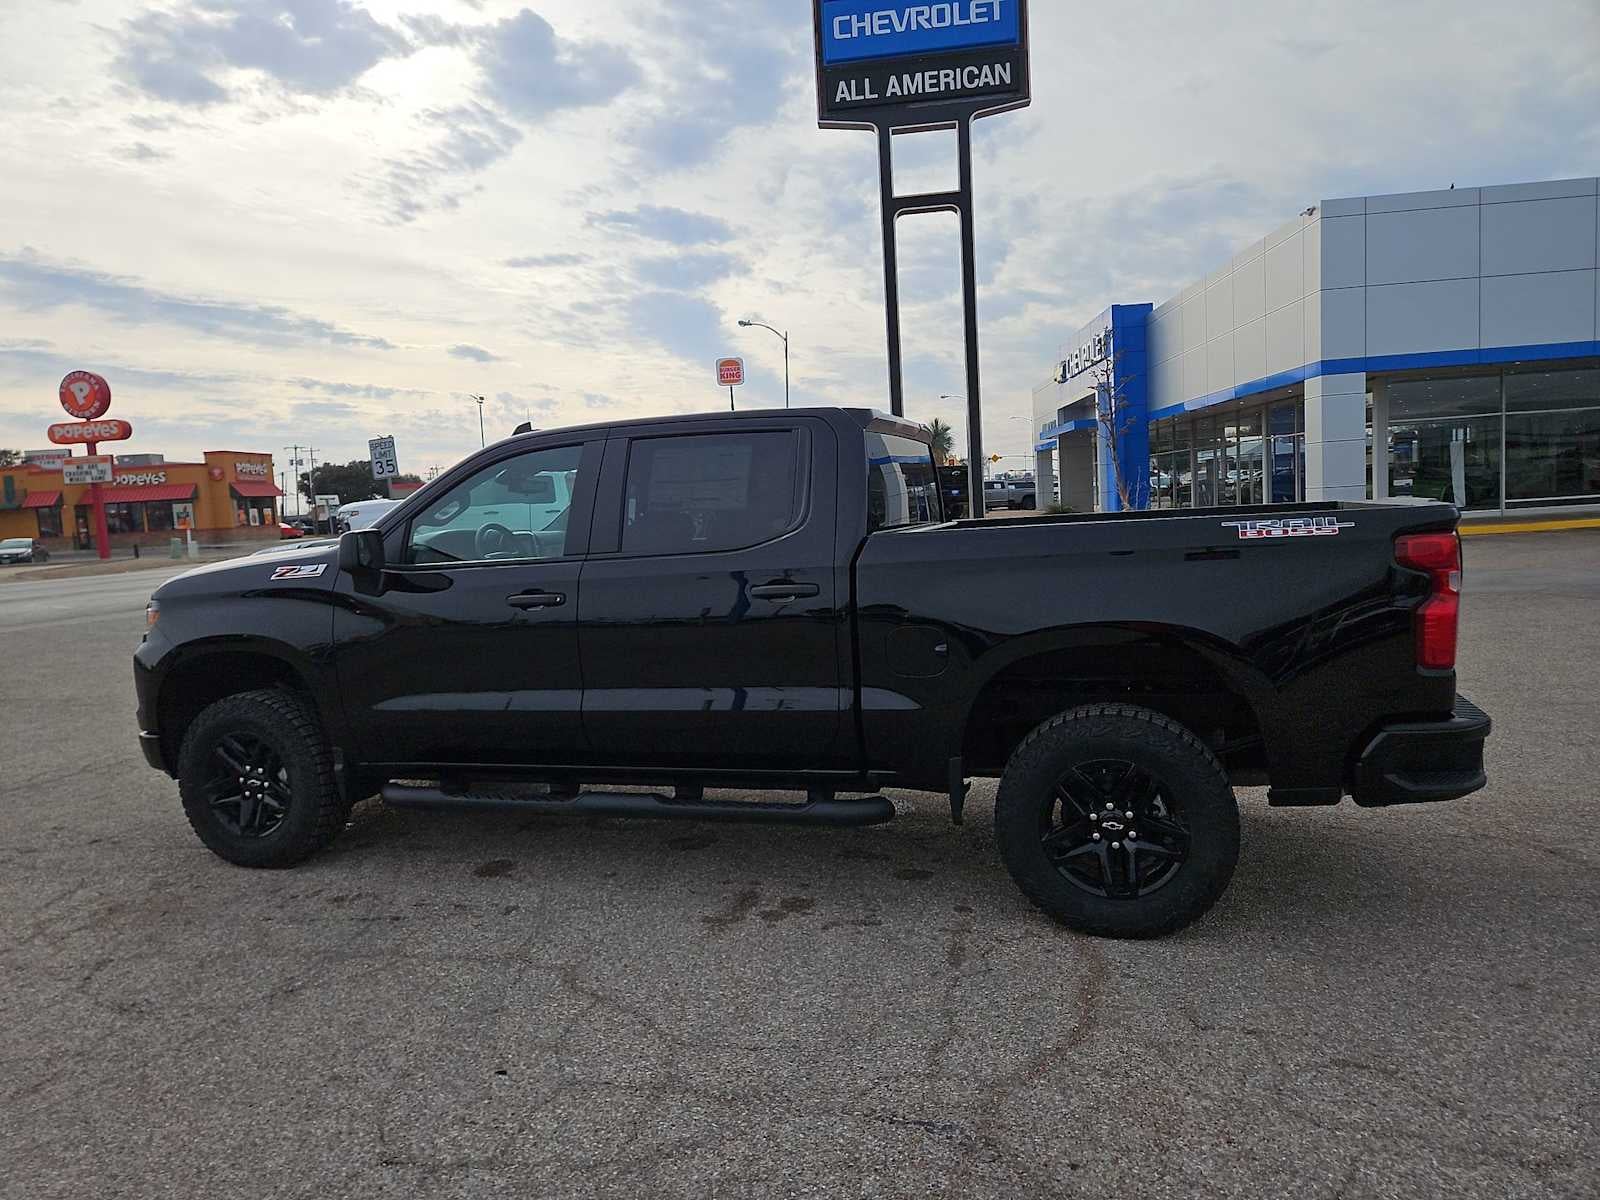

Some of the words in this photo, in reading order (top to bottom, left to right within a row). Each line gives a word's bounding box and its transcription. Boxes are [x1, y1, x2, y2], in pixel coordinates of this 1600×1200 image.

[833, 0, 1005, 39] CHEVROLET
[835, 78, 879, 103] ALL
[886, 62, 1012, 97] AMERICAN
[52, 421, 119, 439] POPEYES
[369, 440, 393, 451] SPEED
[374, 449, 394, 460] LIMIT
[375, 459, 396, 475] 35
[1221, 516, 1355, 530] TRAIL
[1239, 527, 1339, 539] BOSS
[270, 563, 328, 580] Z71
